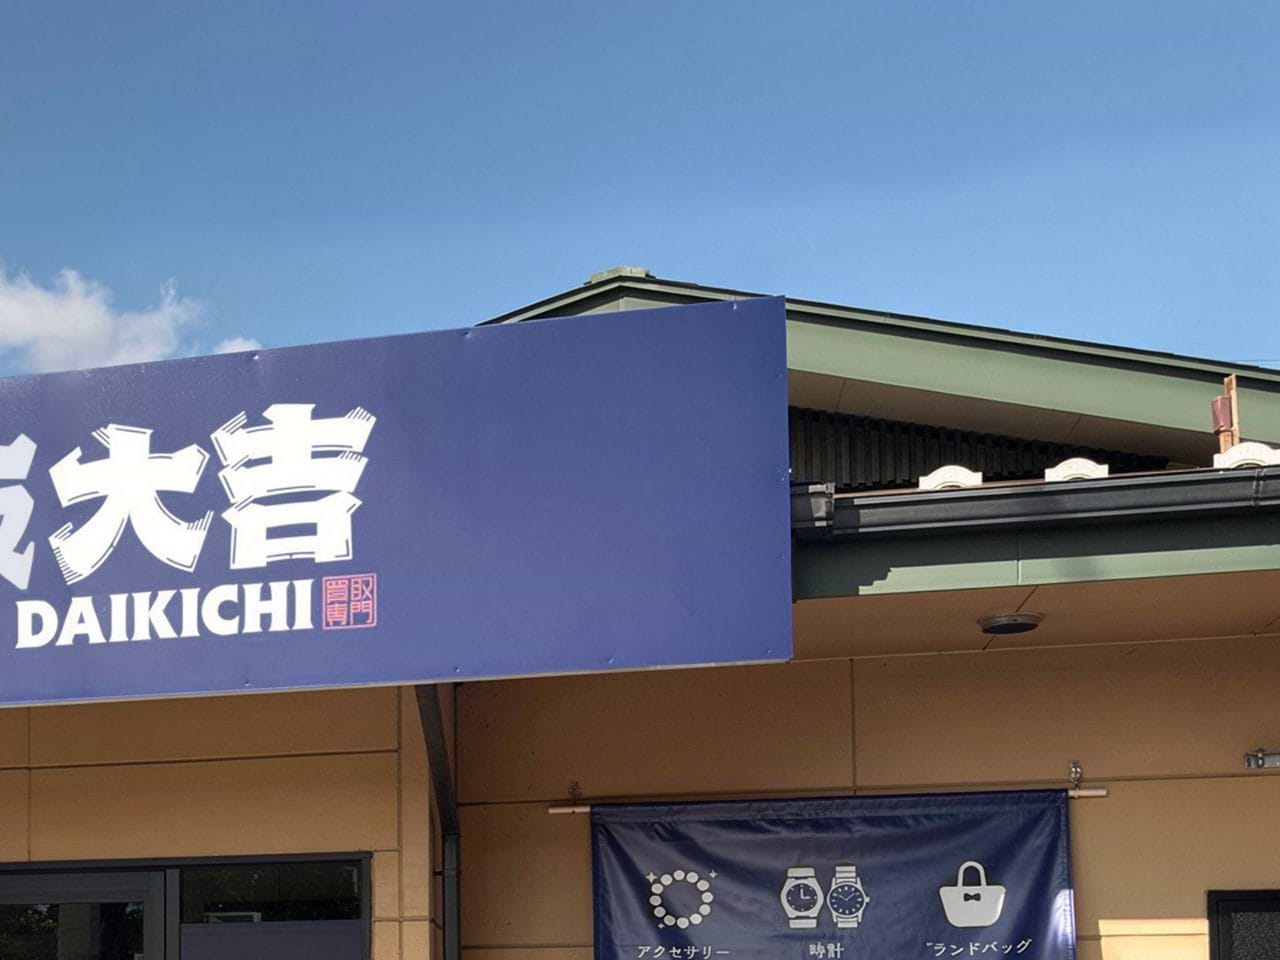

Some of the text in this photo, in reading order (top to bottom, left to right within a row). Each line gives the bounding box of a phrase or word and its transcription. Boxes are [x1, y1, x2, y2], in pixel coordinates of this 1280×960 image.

[15, 578, 315, 649] DAIKICHI
[637, 945, 730, 960] アクセサリー
[809, 942, 844, 959] 時計
[926, 938, 1032, 957] ランドバッグ
